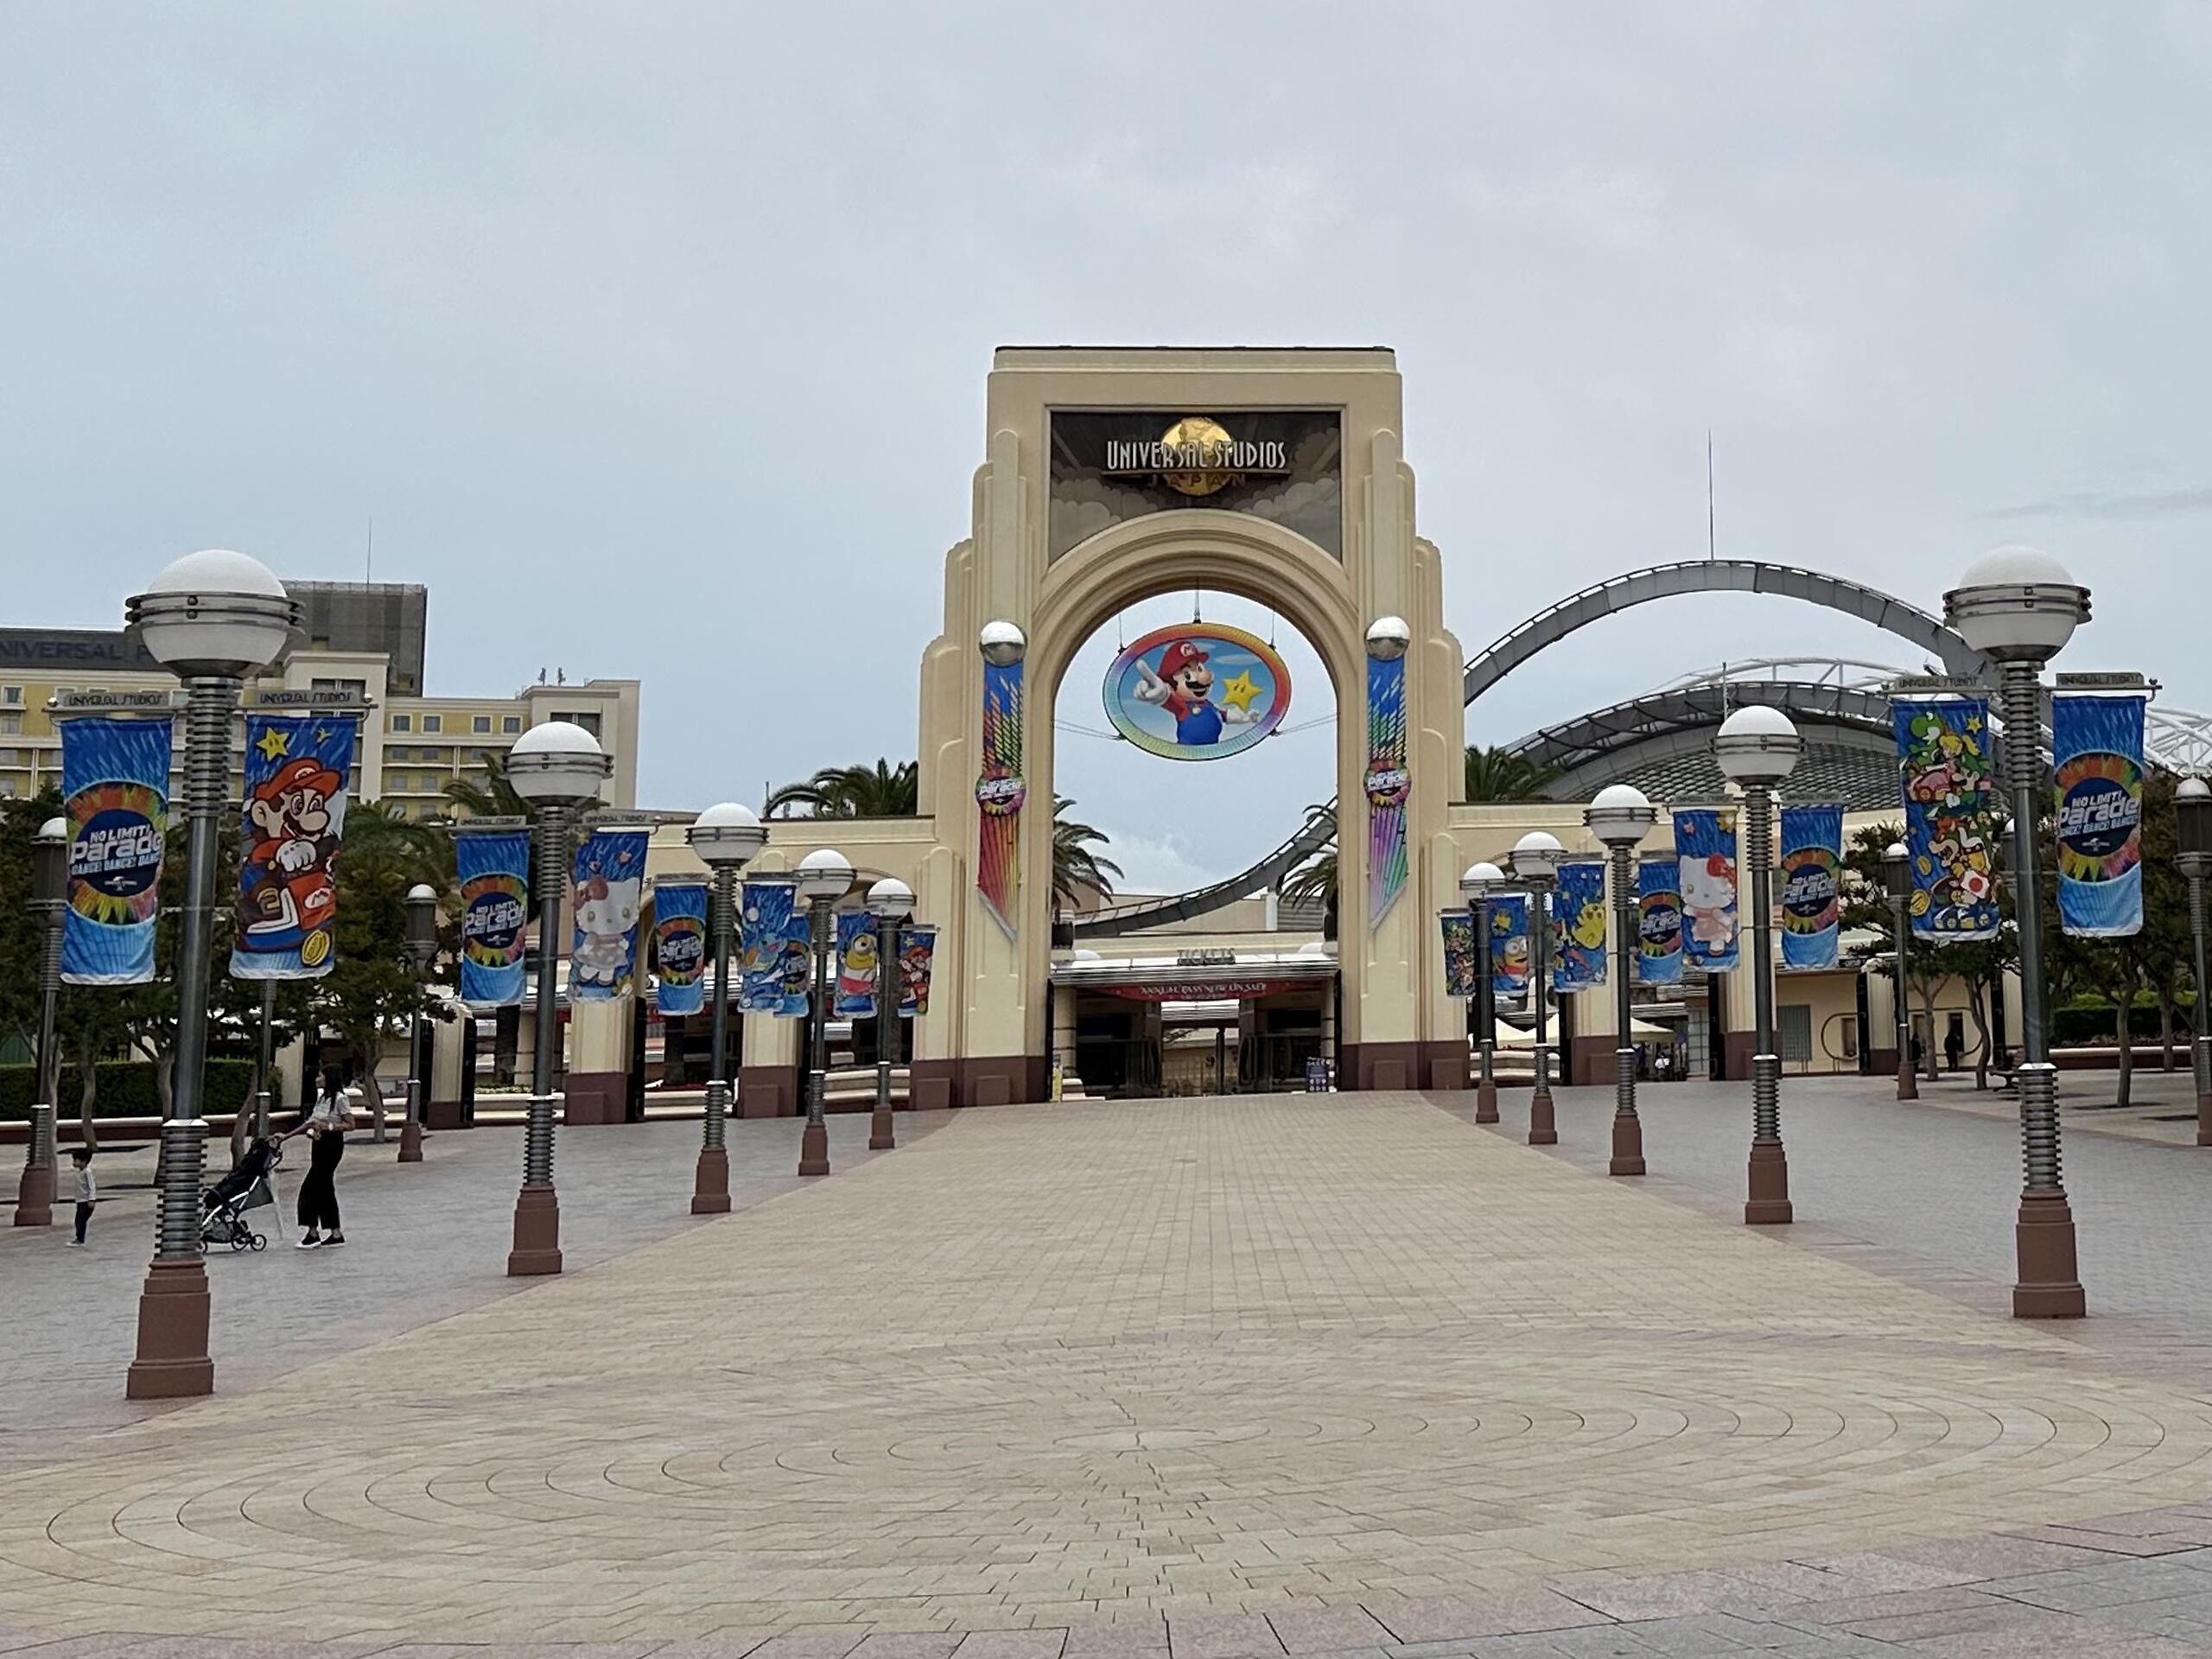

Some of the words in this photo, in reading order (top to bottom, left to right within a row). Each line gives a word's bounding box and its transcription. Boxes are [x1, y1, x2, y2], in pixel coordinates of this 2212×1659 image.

[1107, 441, 1208, 470] UNIVERSAL
[1214, 441, 1287, 468] STUDIOS
[1152, 474, 1246, 487] JAPAN
[68, 694, 118, 706] UNIVERSAL
[119, 693, 162, 705] STUDIOS
[260, 693, 310, 703] UNIVERSAL
[312, 692, 353, 702] STUDIOS
[2072, 796, 2089, 808] NO
[2089, 790, 2123, 806] LIMIT!
[90, 830, 106, 843] NO
[107, 823, 151, 841] LIMIT!
